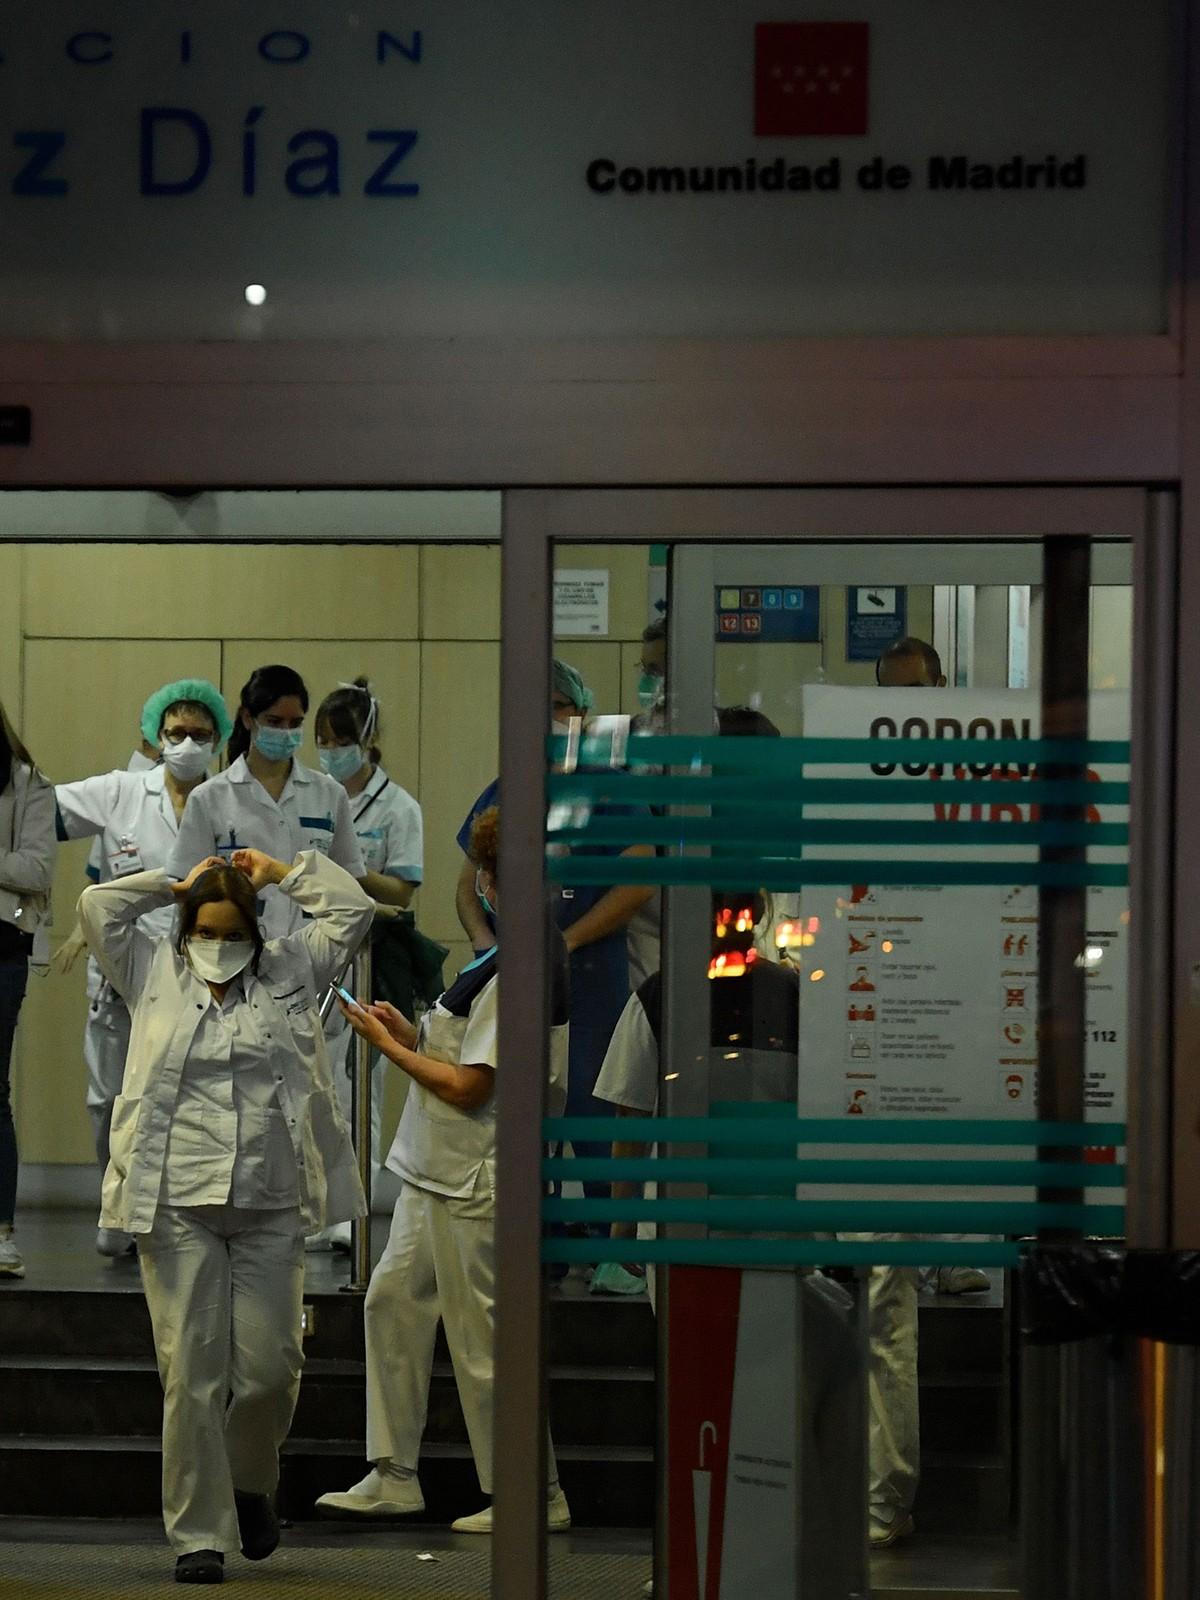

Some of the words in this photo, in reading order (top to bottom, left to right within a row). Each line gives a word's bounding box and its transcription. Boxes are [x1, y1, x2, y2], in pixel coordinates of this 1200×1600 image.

[139, 106, 420, 198] Díaz
[586, 156, 841, 193] Comunidad
[858, 157, 912, 191] de
[929, 154, 1086, 190] Madrid
[870, 717, 1031, 776] CORON
[1093, 1031, 1117, 1042] 112
